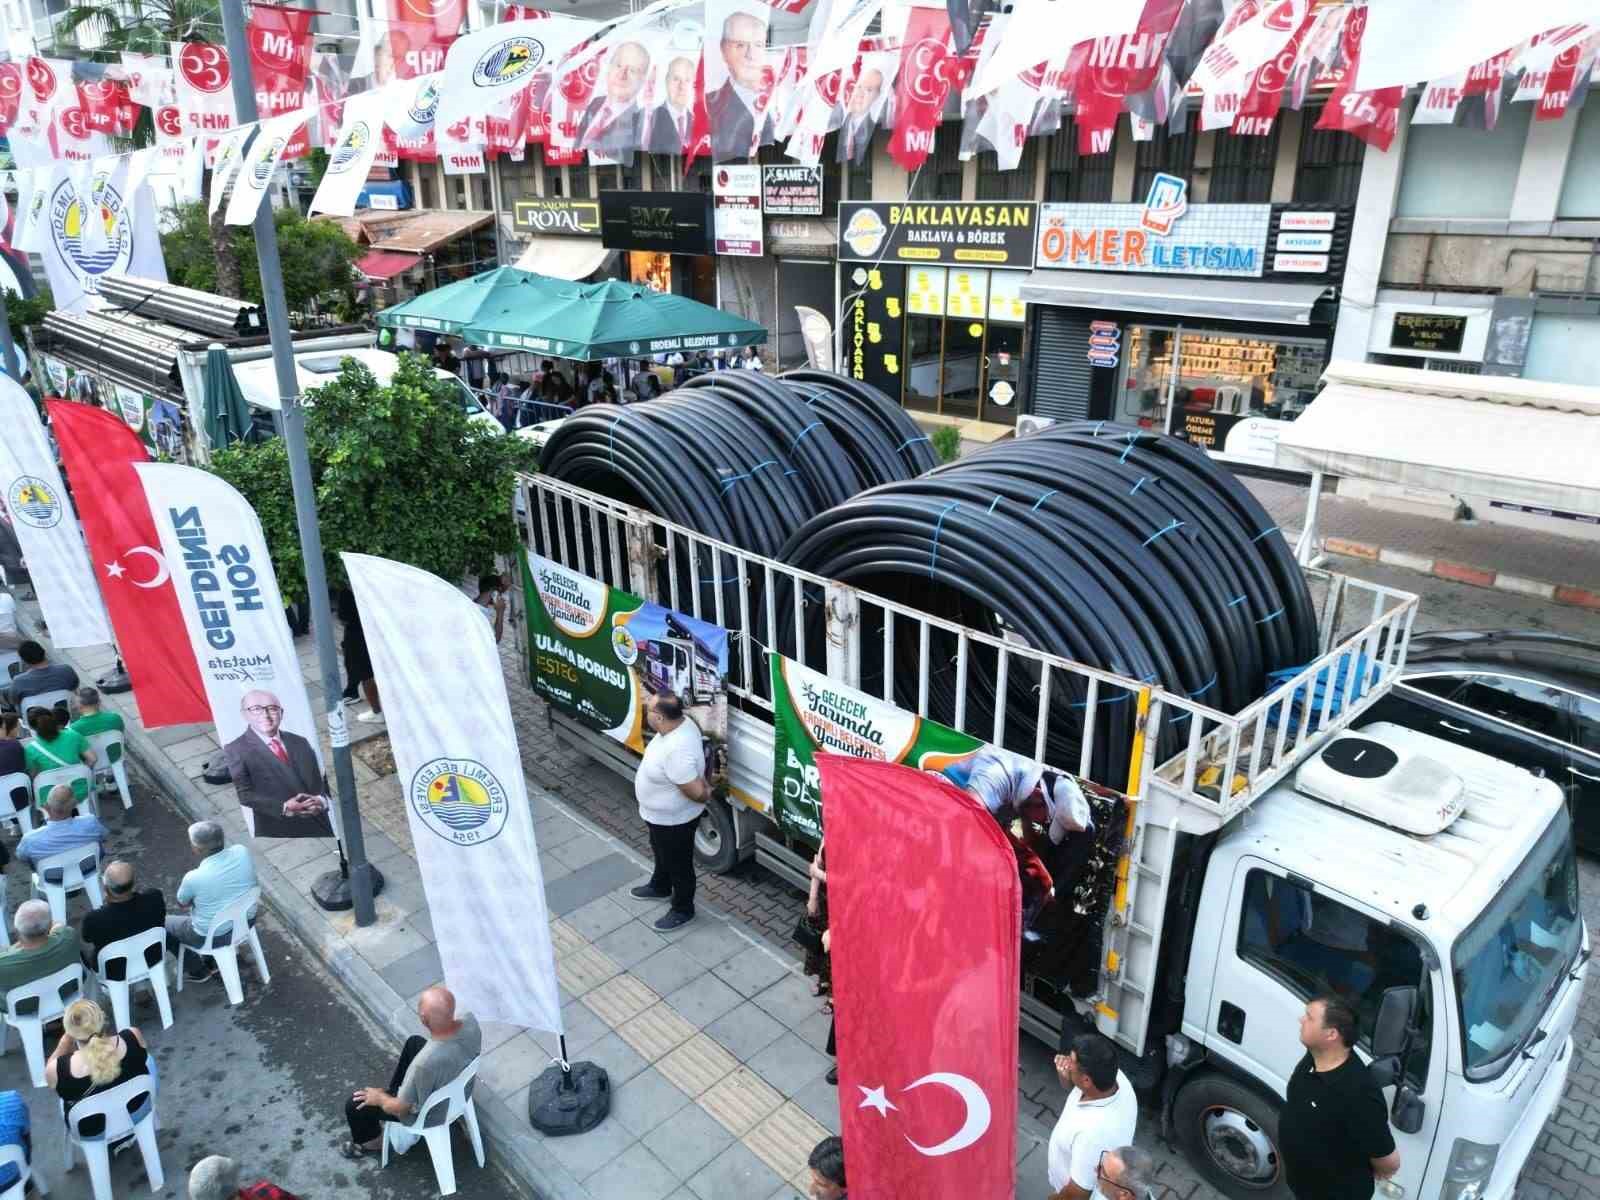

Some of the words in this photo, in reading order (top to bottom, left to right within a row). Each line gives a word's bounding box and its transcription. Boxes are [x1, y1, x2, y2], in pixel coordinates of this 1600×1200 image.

[527, 210, 591, 232] ROYAL
[889, 206, 1029, 227] BAKLAVASAN
[908, 229, 954, 243] BAKLAVA
[957, 231, 965, 243] &
[1041, 216, 1148, 267] ÖMER
[576, 653, 626, 690] BORUSU
[822, 689, 868, 721] GELECEK
